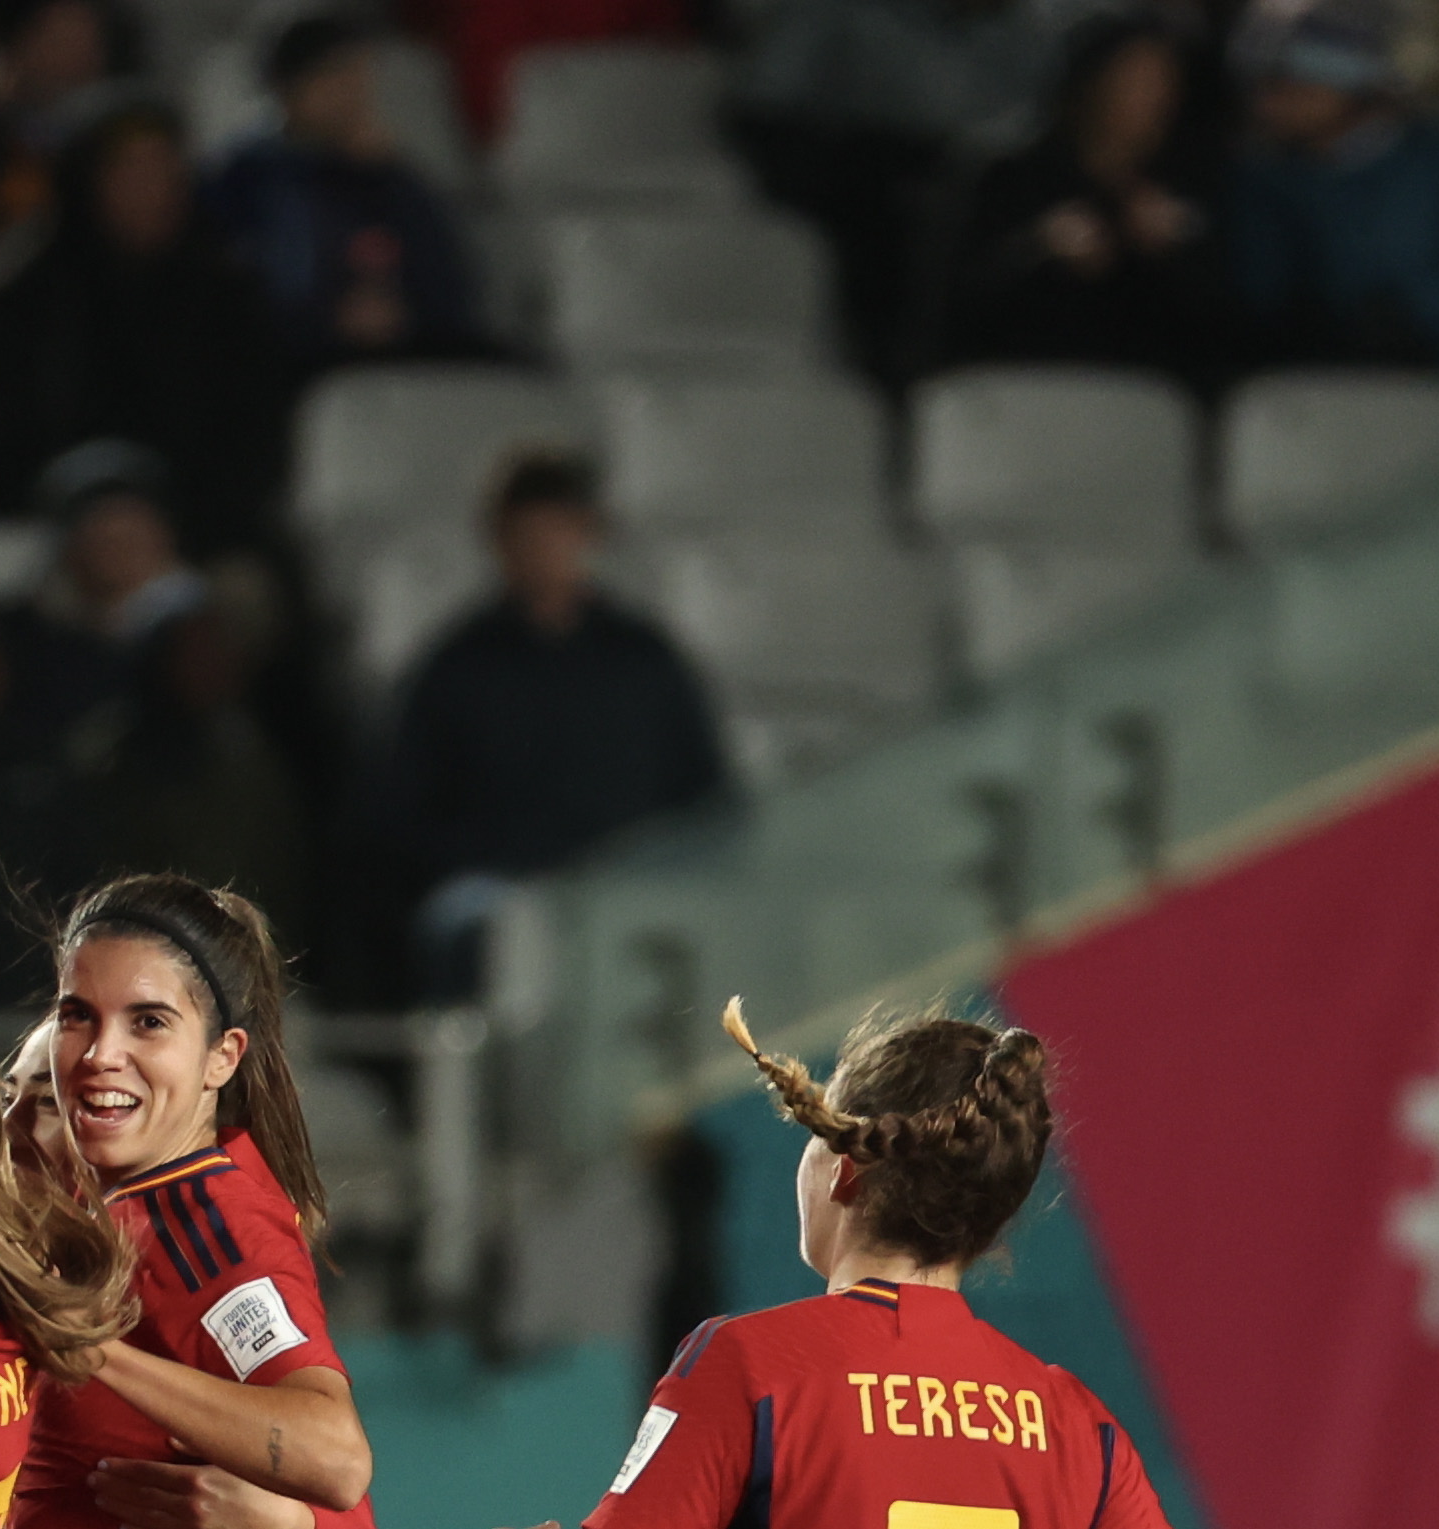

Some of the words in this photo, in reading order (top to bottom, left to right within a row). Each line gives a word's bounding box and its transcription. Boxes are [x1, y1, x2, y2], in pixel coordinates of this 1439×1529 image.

[222, 1294, 263, 1326] FOOTBALL
[229, 1302, 270, 1338] UNITES
[236, 1330, 253, 1350] the
[846, 1371, 1049, 1453] TERESA
